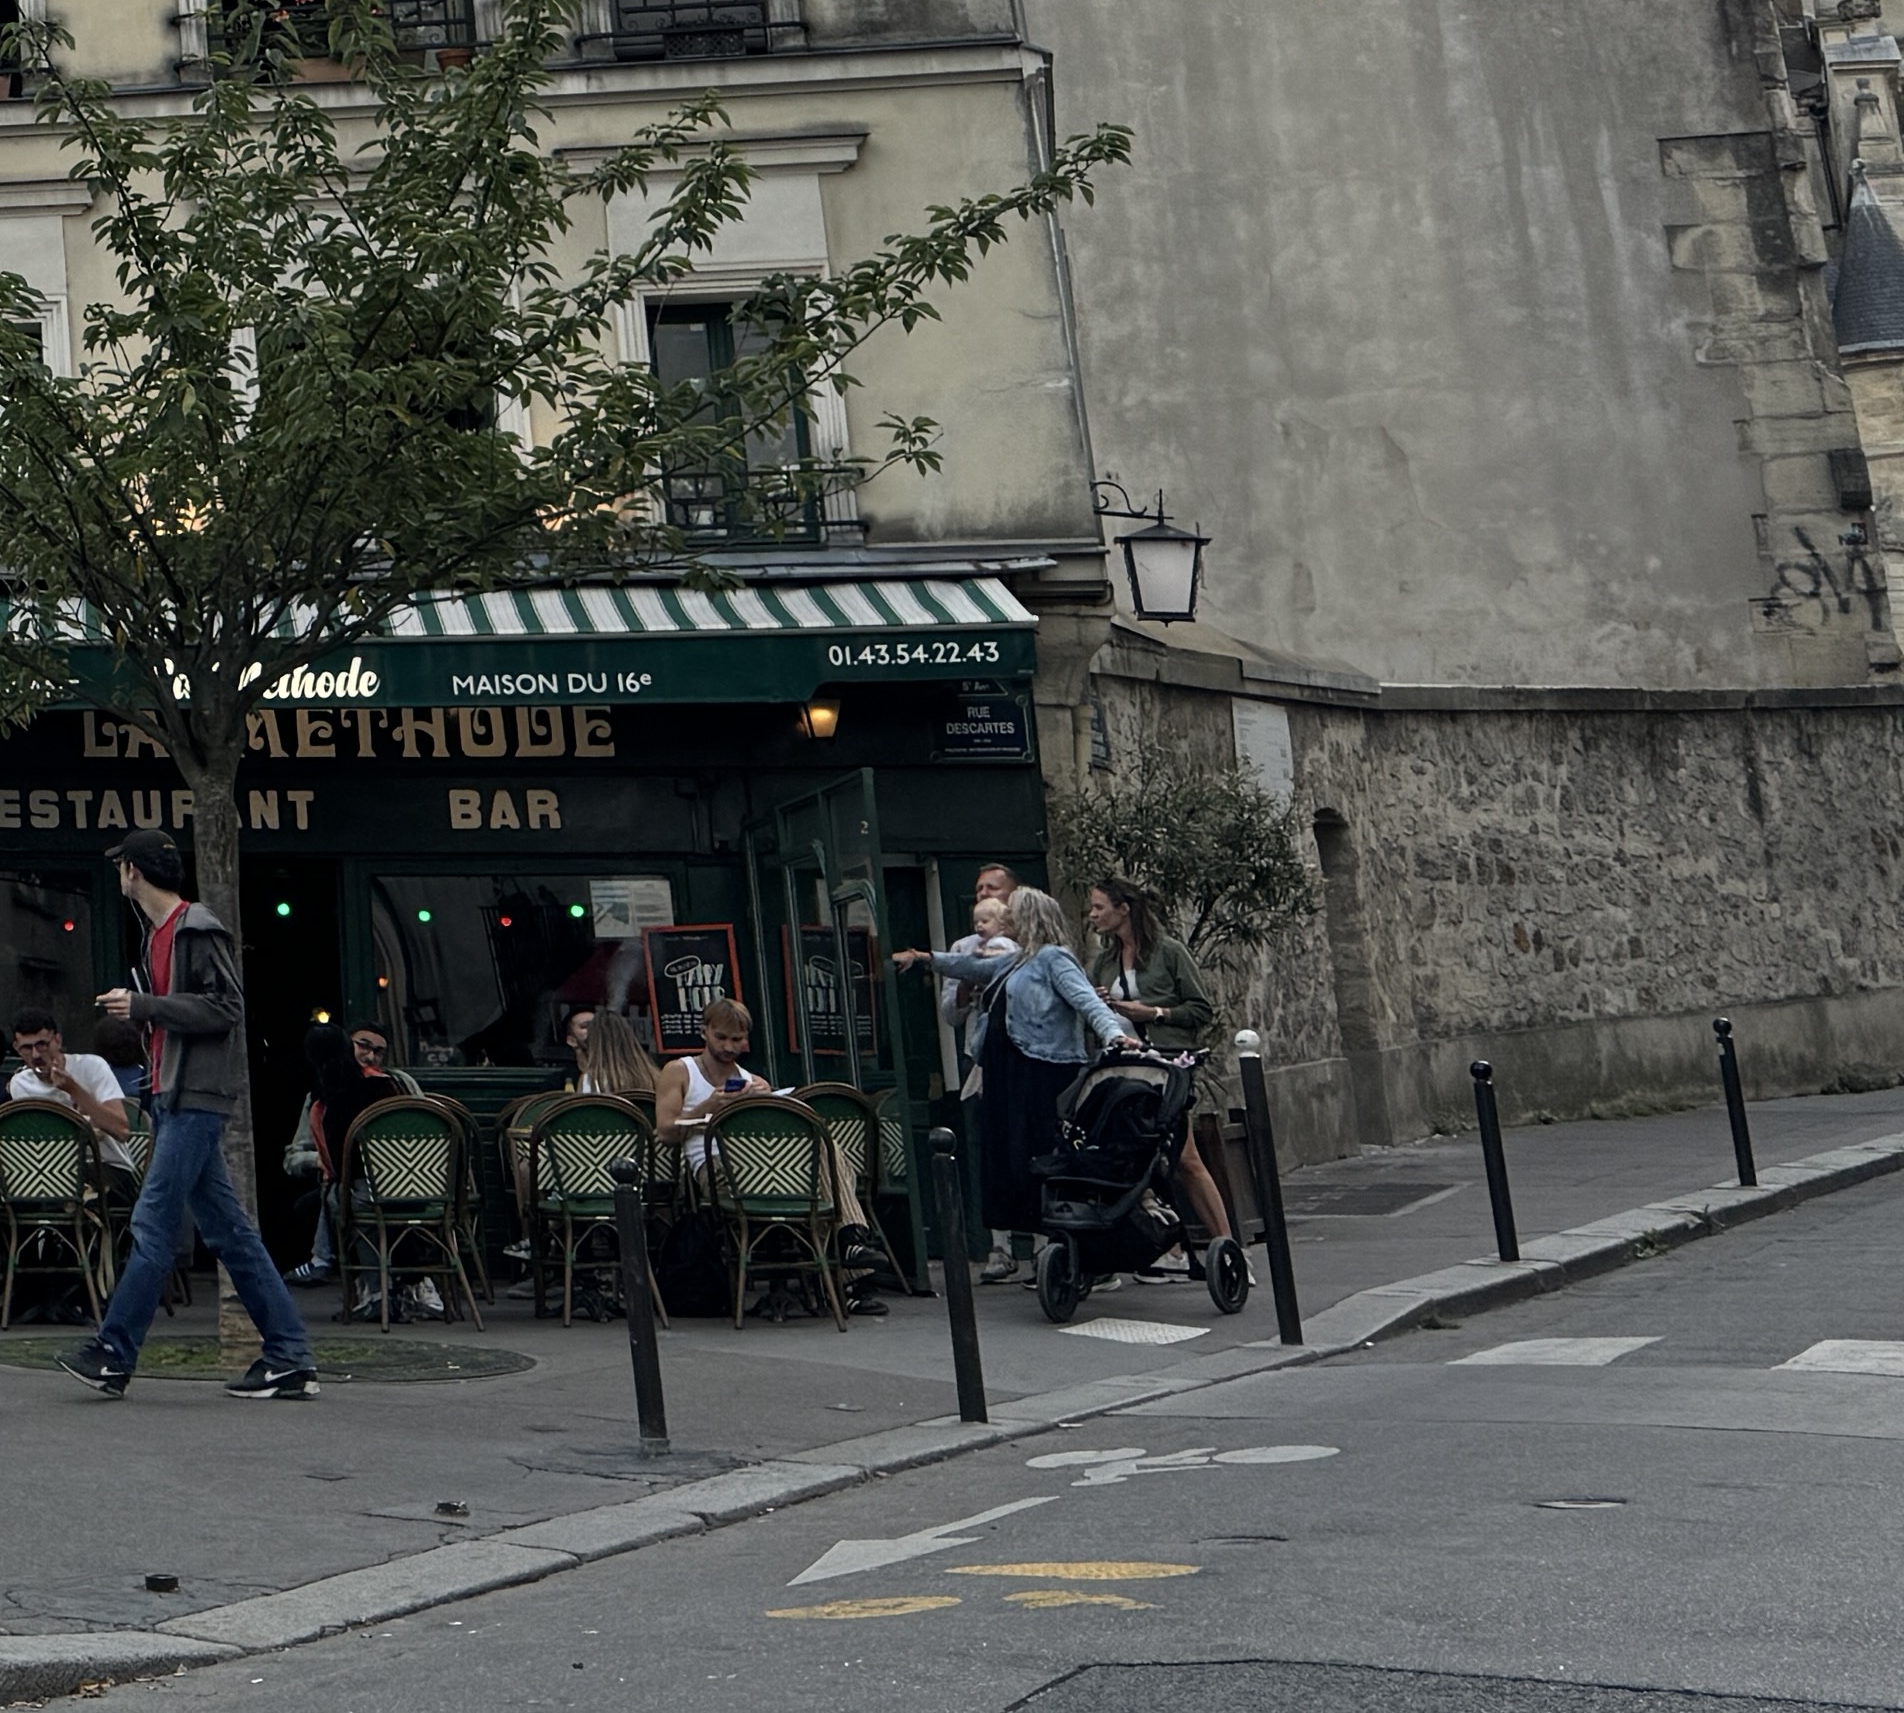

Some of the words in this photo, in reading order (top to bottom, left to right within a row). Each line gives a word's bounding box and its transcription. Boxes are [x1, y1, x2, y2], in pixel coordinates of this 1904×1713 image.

[827, 641, 1000, 668] 01.43.54.22.43
[452, 674, 559, 697] MAISON
[567, 673, 609, 695] DU
[616, 673, 652, 694] 16e
[966, 706, 991, 718] RUE
[945, 721, 1016, 735] DESCARTES
[448, 788, 562, 830] BAR
